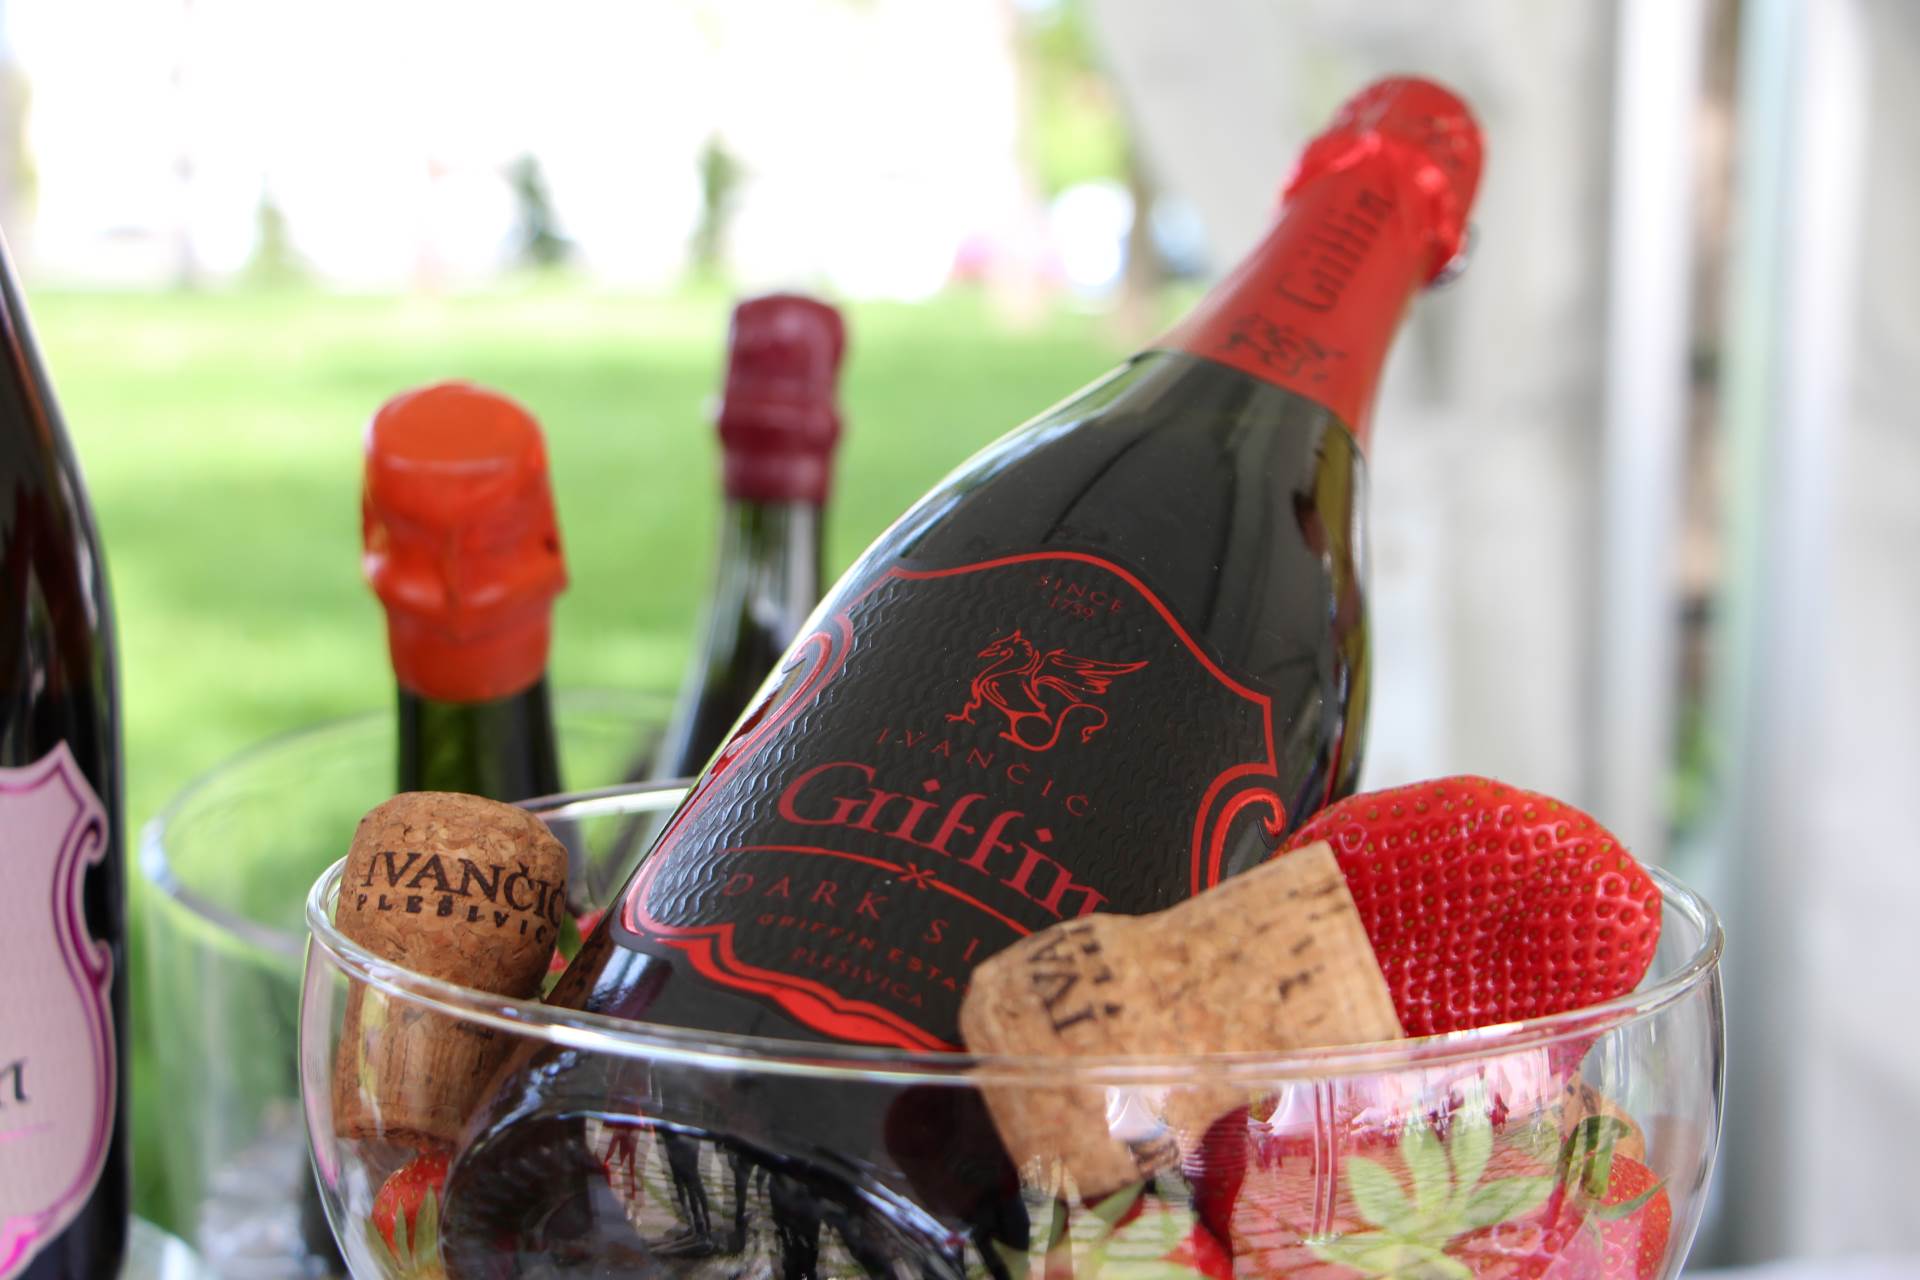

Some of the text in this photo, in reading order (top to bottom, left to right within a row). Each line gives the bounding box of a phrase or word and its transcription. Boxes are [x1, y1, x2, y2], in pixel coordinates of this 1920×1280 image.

[778, 761, 1109, 919] Griffin
[720, 872, 981, 962] DARK SI
[887, 946, 972, 998] ESTA
